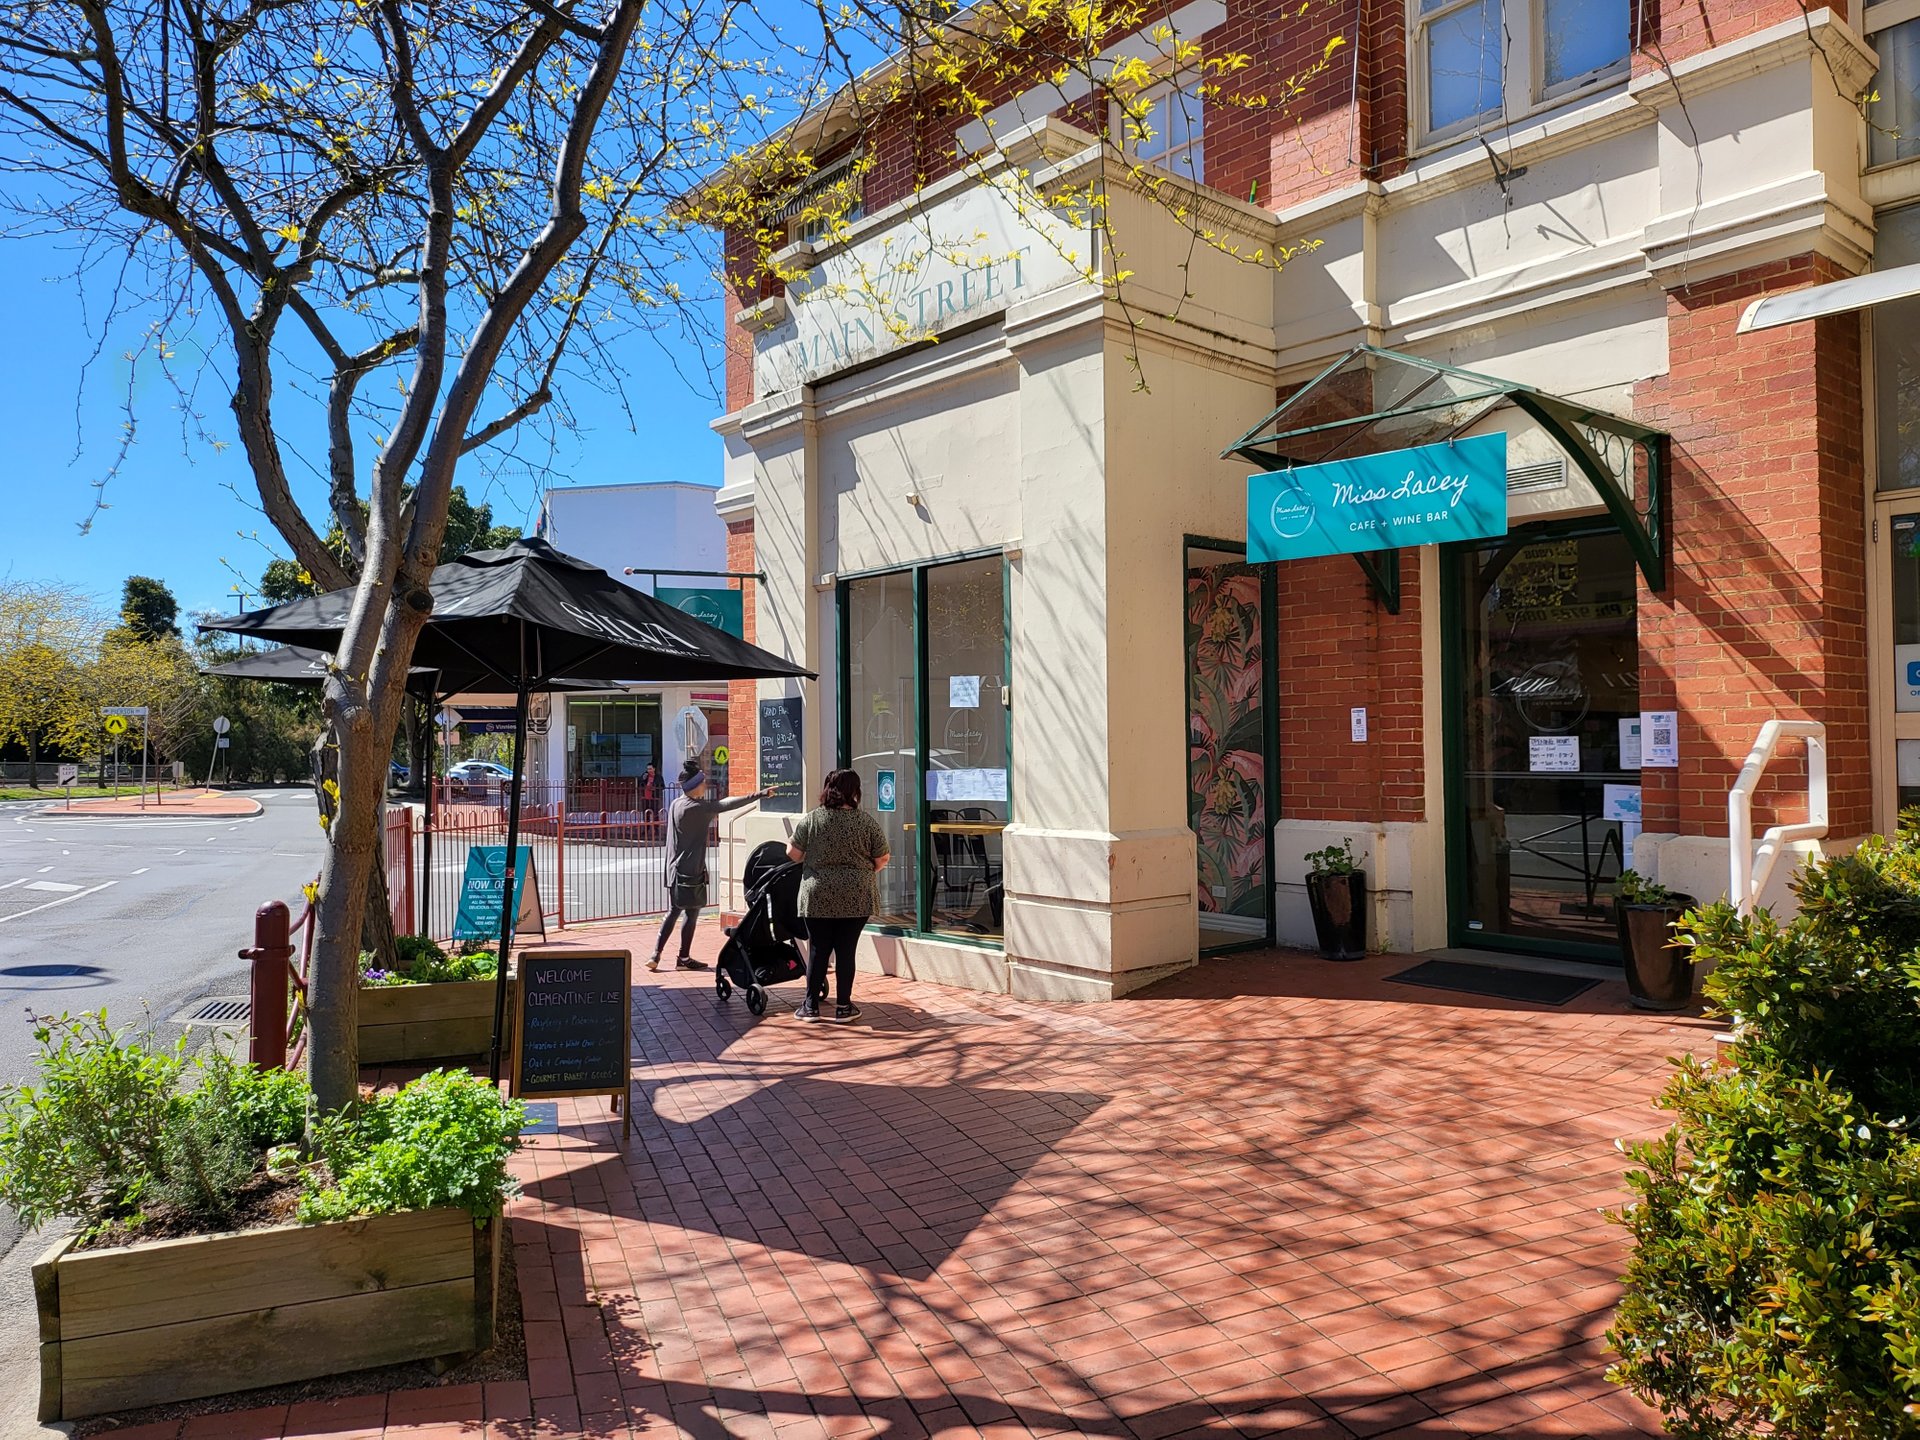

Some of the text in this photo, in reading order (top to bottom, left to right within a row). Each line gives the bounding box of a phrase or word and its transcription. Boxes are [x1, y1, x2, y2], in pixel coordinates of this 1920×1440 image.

[797, 245, 1031, 371] MAIN STREET
[1332, 470, 1470, 509] Miss Lacey
[1349, 510, 1449, 532] CAFE + WINE BAR
[559, 600, 701, 650] SILVA
[468, 879, 519, 890] NOW OPN
[536, 969, 593, 984] WELCOME
[528, 991, 595, 1007] CLEMENTINE
[530, 1072, 561, 1085] GOURMET
